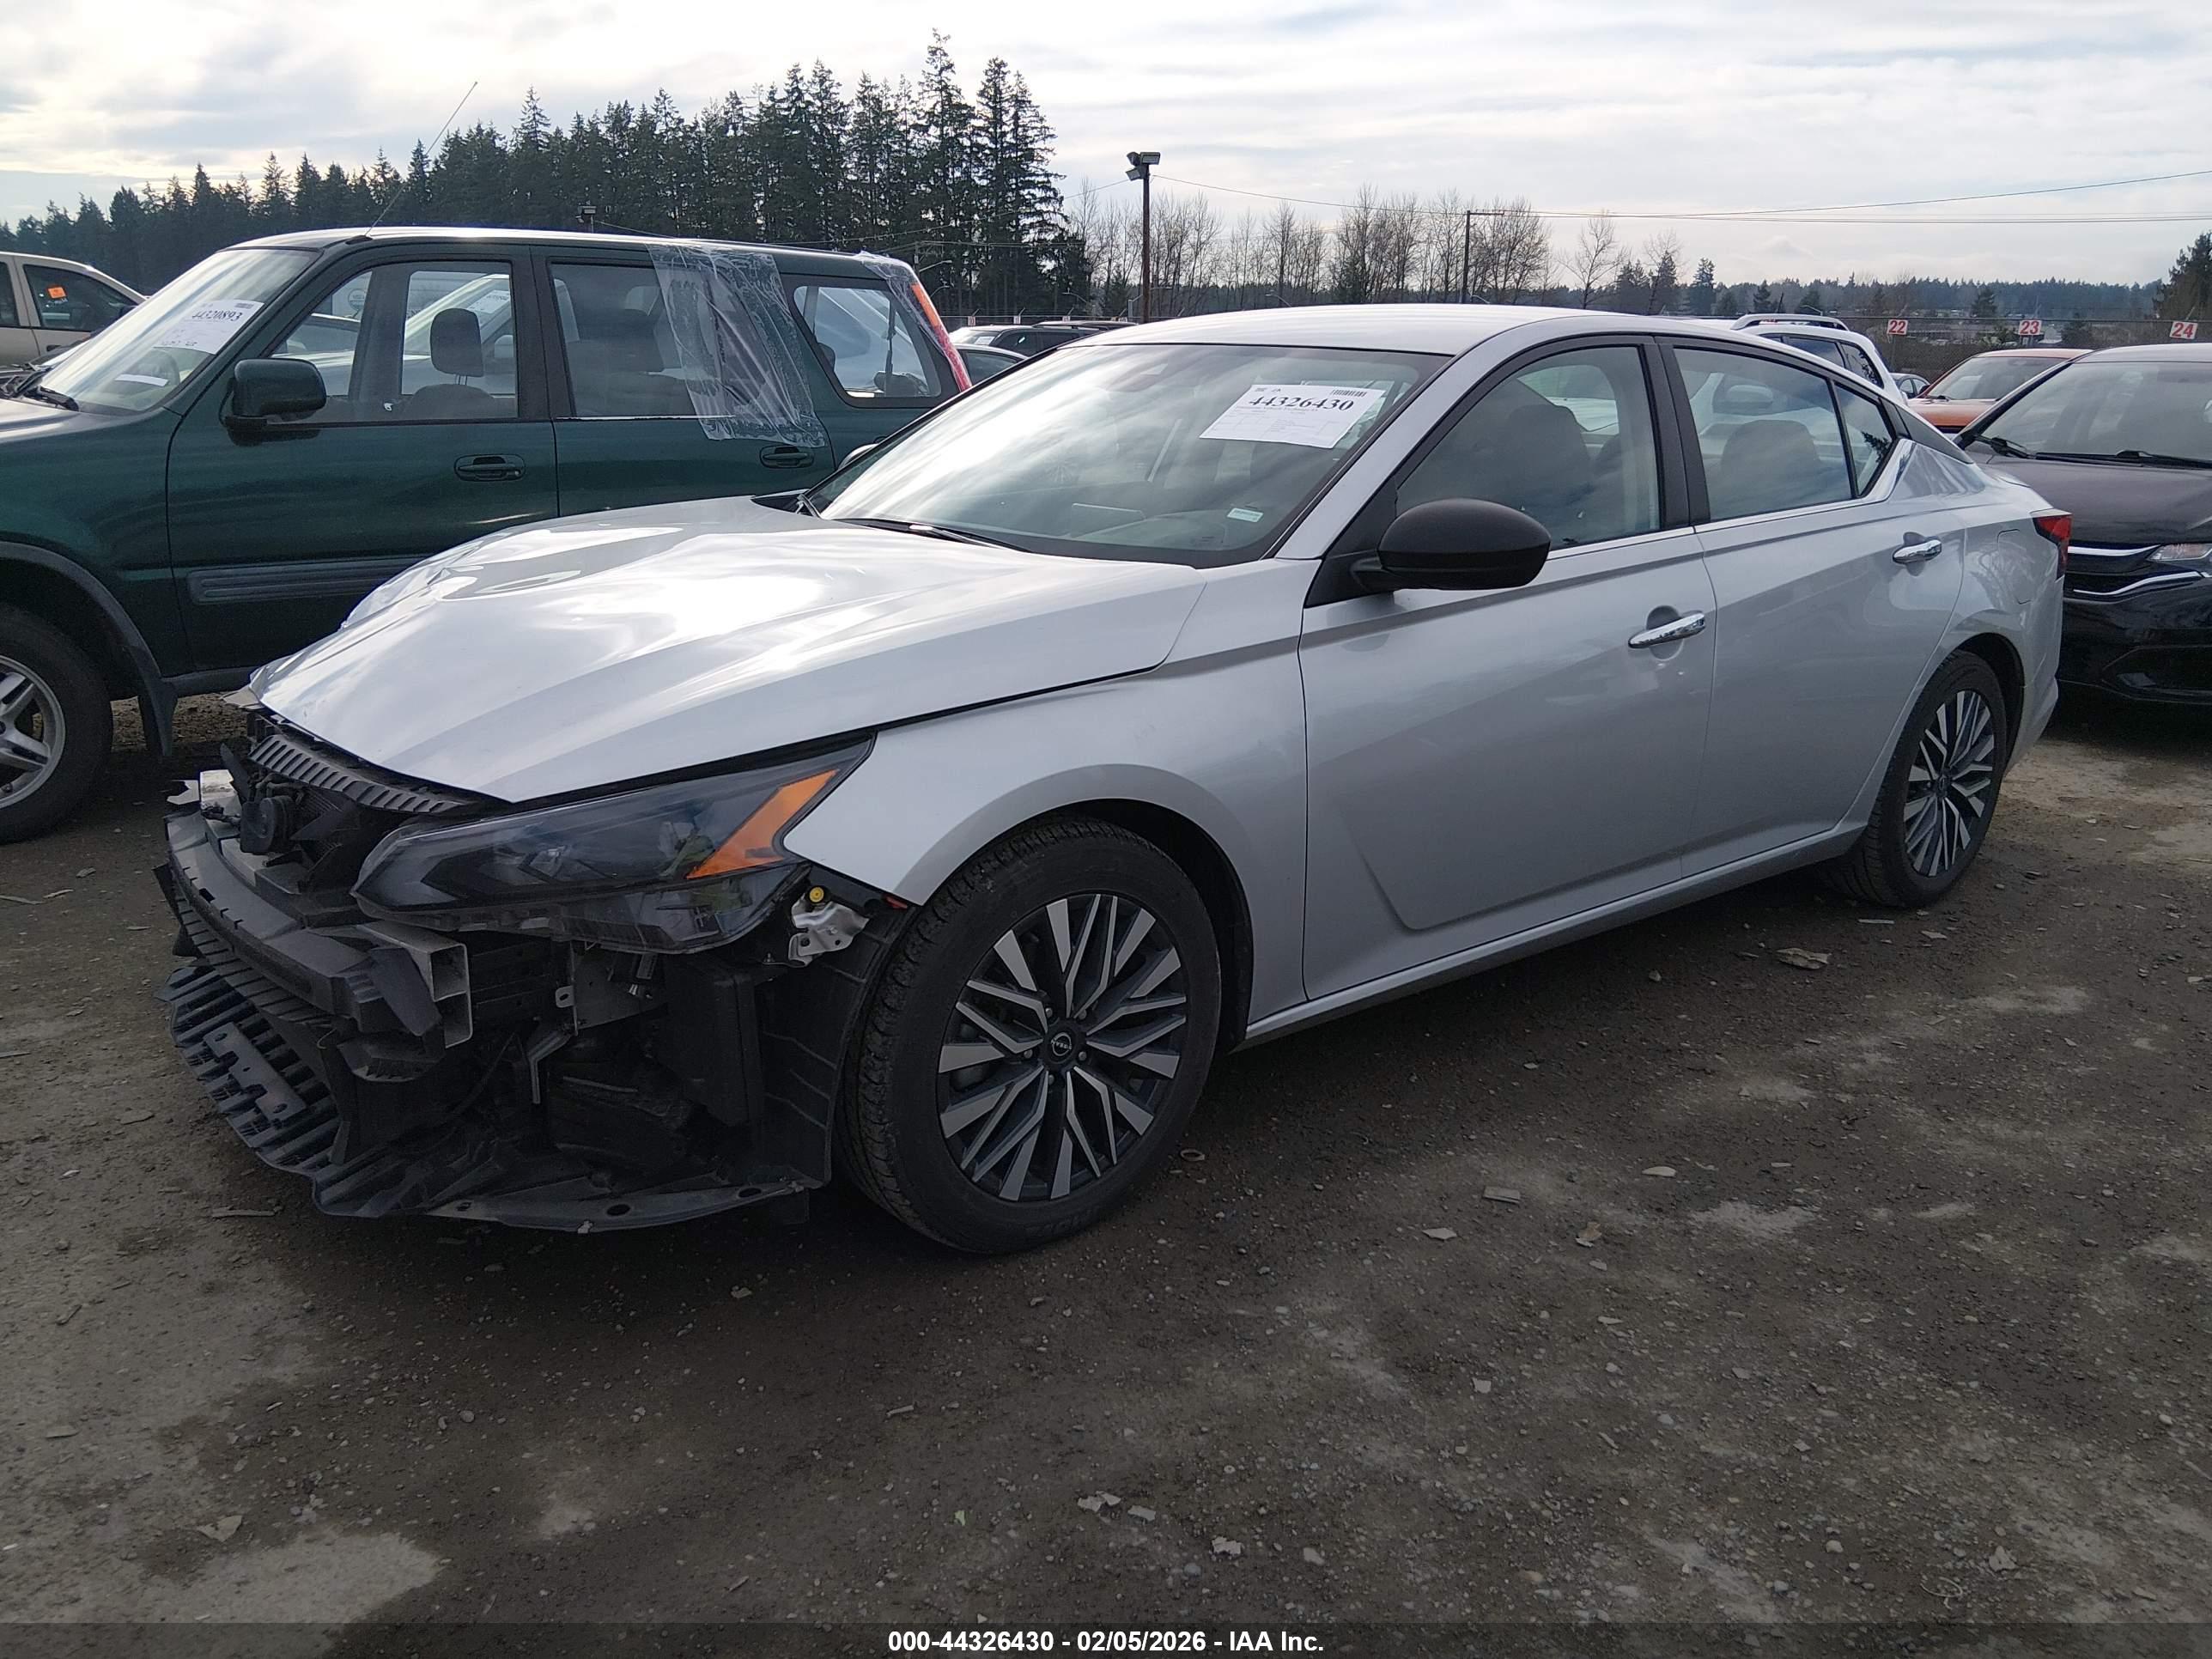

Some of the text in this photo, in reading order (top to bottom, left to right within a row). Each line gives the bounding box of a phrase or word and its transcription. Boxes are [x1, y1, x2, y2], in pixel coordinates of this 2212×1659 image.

[1889, 320, 1906, 333] 22
[2020, 320, 2039, 334] 23
[2172, 322, 2194, 337] 24
[1249, 396, 1354, 411] 44326430
